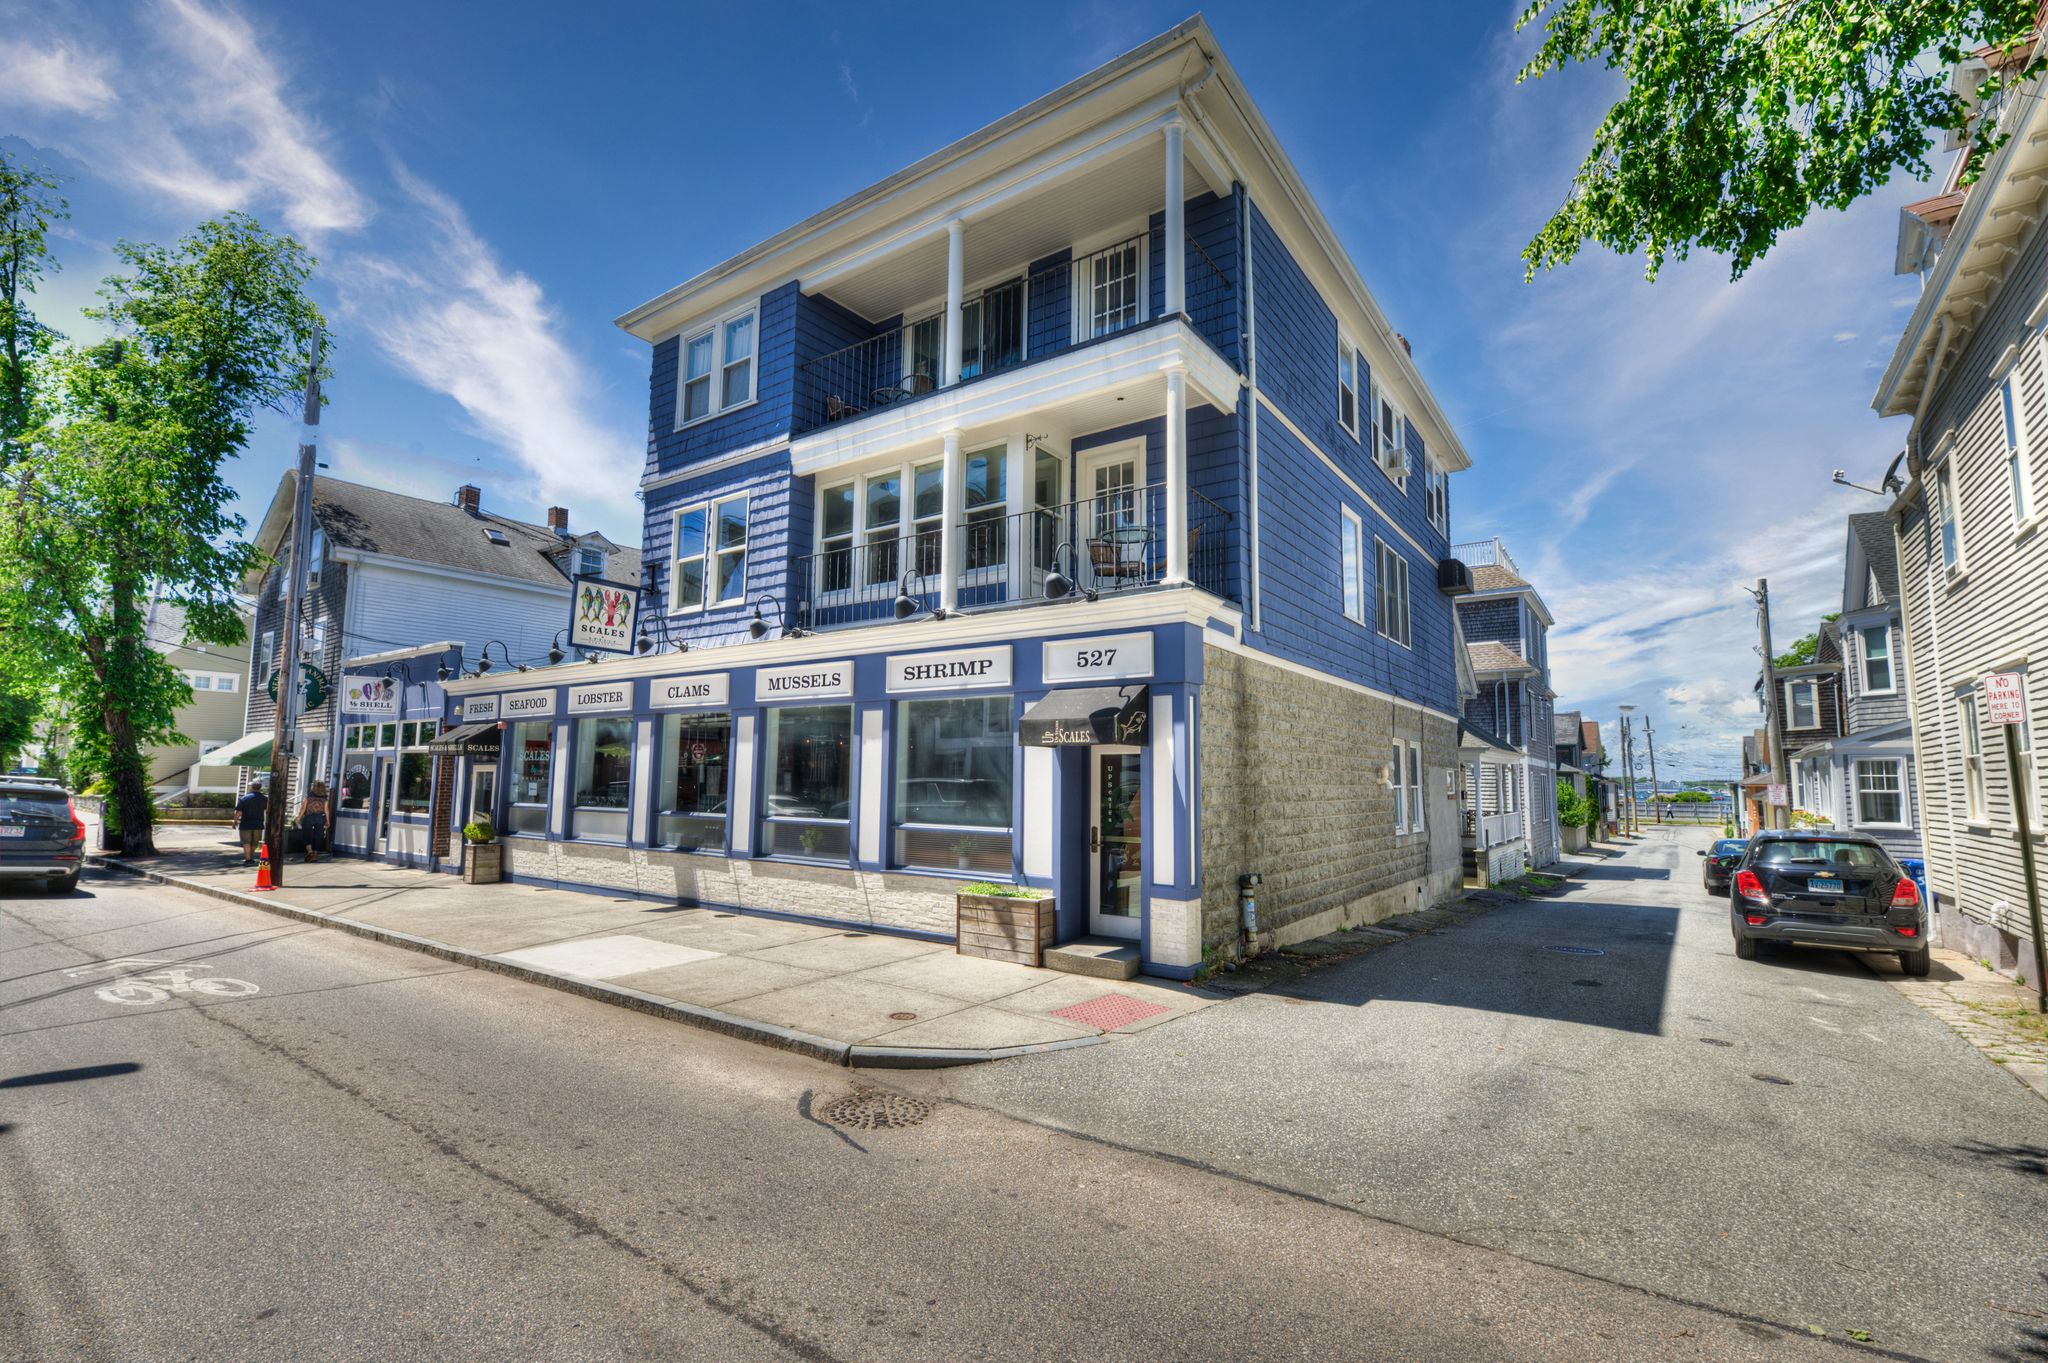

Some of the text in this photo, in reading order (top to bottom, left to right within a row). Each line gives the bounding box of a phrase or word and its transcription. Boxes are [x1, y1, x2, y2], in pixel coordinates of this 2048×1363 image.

[581, 624, 625, 638] SCALES
[1076, 649, 1117, 668] 527
[903, 659, 993, 681] SHRIMP
[768, 673, 841, 691] MUSSELS
[1995, 679, 2008, 688] NO
[667, 684, 710, 699] CLAMS
[1989, 690, 2019, 700] PARKING
[509, 697, 547, 711] SEAFOOD
[578, 691, 623, 705] LOBSTER
[360, 701, 393, 709] SHELL
[469, 702, 494, 714] FRESH
[2012, 701, 2019, 709] TO
[1994, 711, 2020, 719] CORNER
[467, 744, 500, 752] SCALES
[520, 751, 550, 761] SCALES
